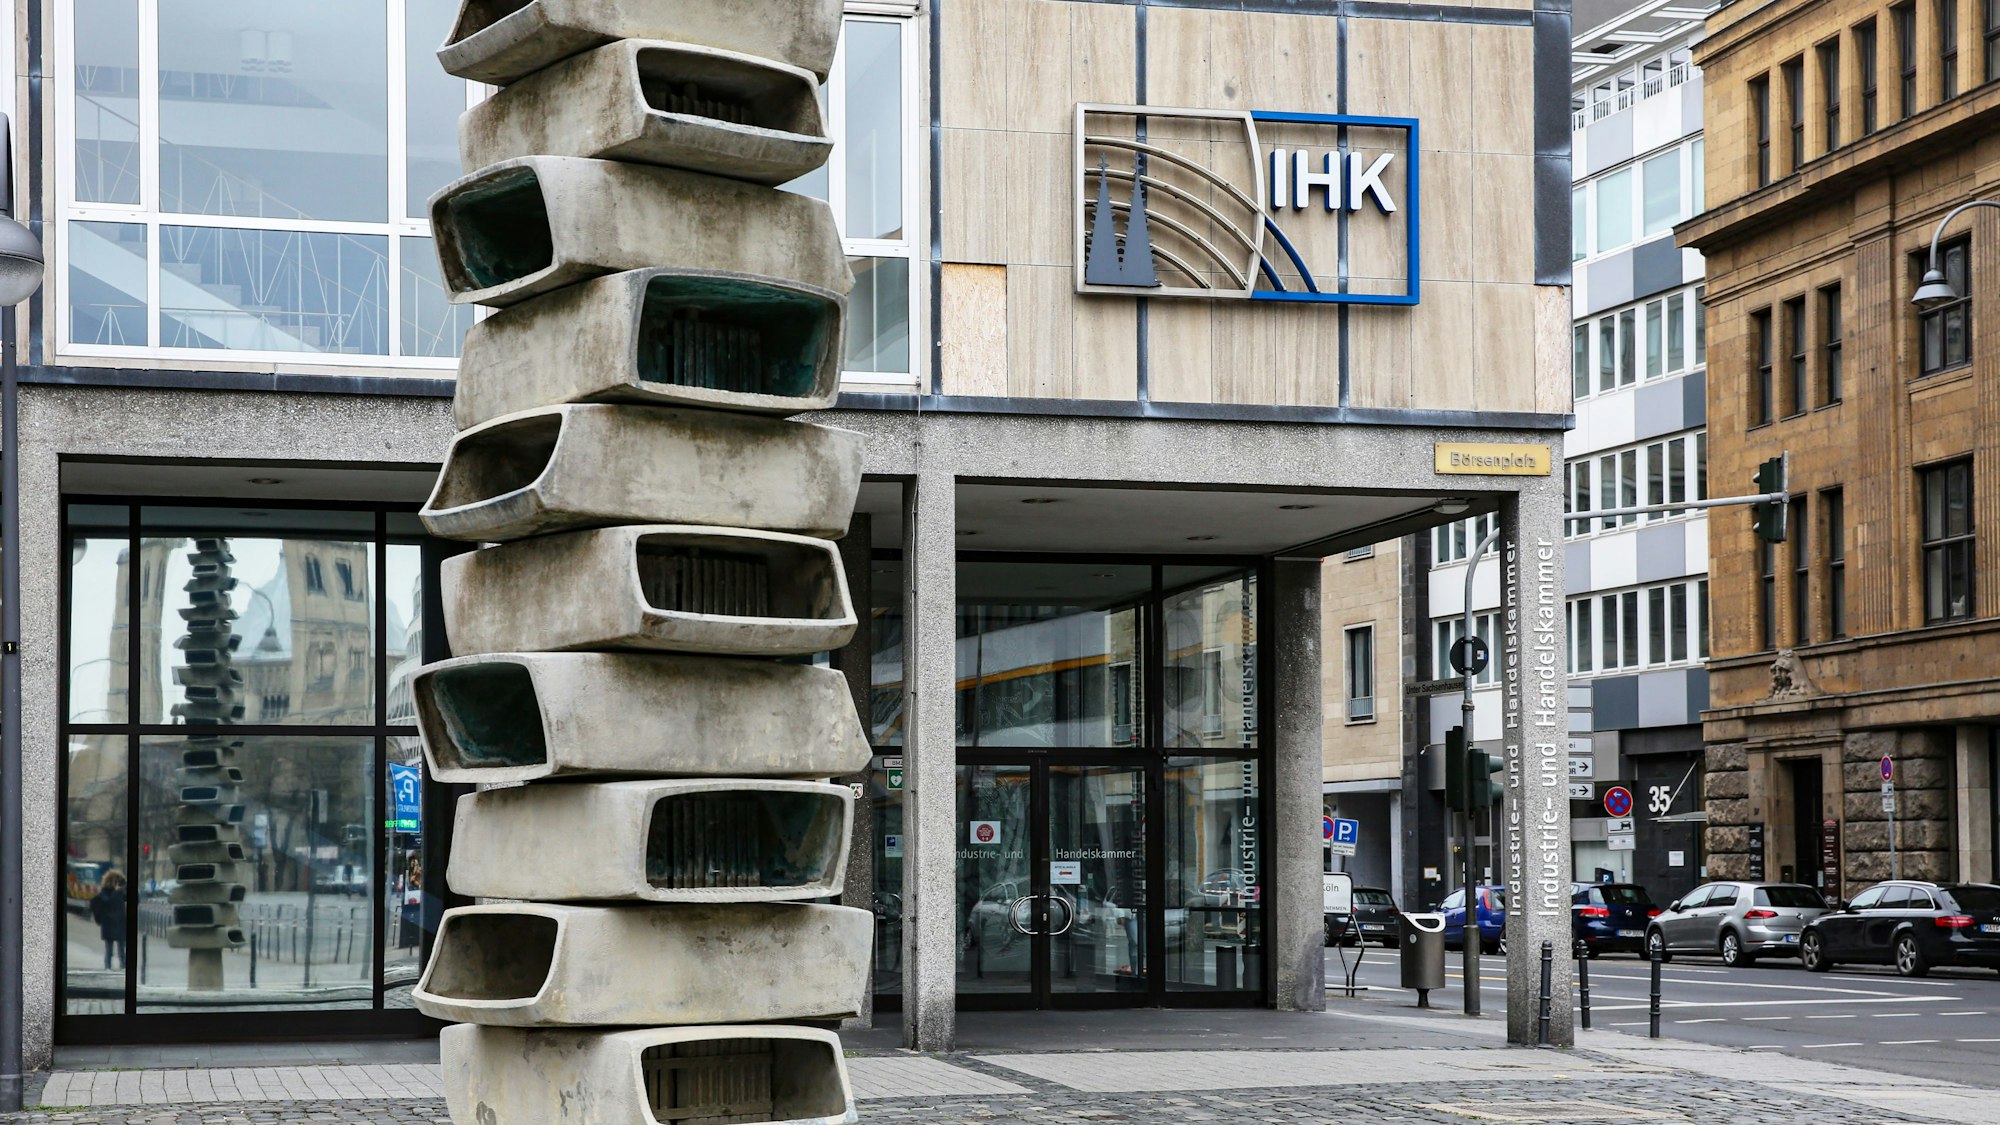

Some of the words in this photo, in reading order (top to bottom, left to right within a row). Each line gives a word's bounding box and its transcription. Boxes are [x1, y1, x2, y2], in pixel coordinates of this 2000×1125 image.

[1271, 148, 1397, 213] IHK
[1450, 451, 1537, 470] Börsenplatz
[7, 642, 12, 652] 1
[1505, 541, 1518, 729] Handelskammer
[1534, 537, 1556, 727] Handelskammer
[1406, 685, 1422, 695] Unter
[1507, 745, 1519, 788] und
[1536, 743, 1558, 787] und
[1648, 785, 1671, 813] 35
[1338, 822, 1352, 840] P
[956, 848, 1000, 859] ndustrie-
[1004, 848, 1023, 859] und
[1056, 848, 1136, 859] Handelskammer
[1238, 805, 1256, 904] Industrie-
[1508, 798, 1521, 916] Industrie-
[1538, 798, 1559, 916] Industrie-
[1603, 874, 1609, 882] P
